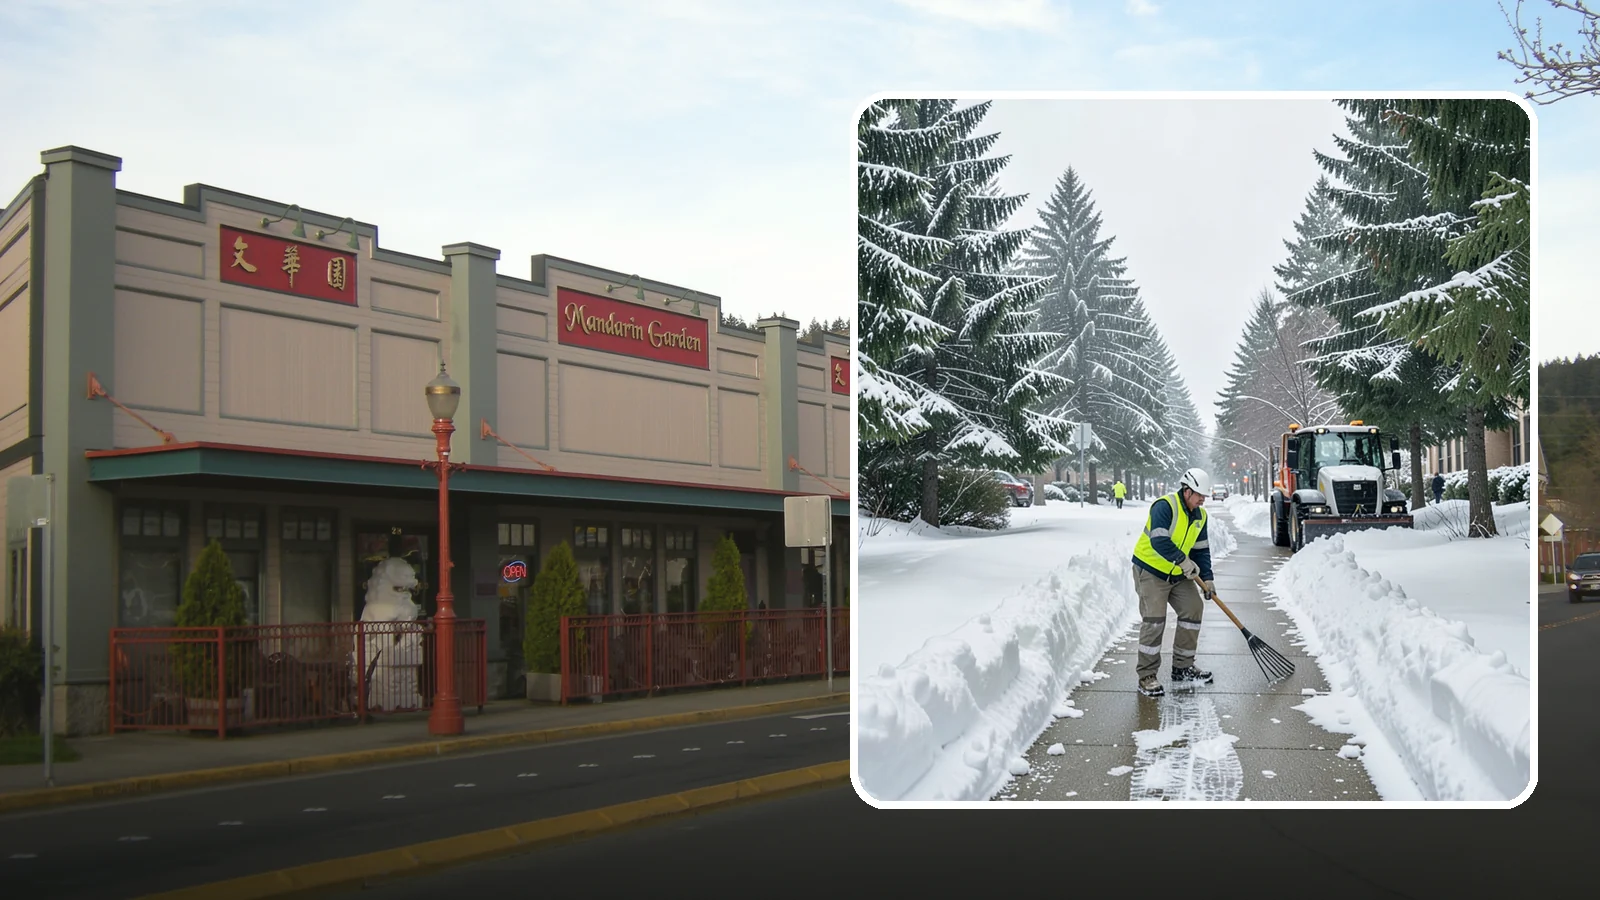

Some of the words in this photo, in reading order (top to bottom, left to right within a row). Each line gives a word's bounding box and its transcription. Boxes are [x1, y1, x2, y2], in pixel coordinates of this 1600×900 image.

[231, 236, 346, 290] 文華園
[564, 302, 644, 341] Mandarin
[648, 321, 701, 352] Garden
[835, 363, 846, 386] 文
[503, 565, 527, 578] OPEN
